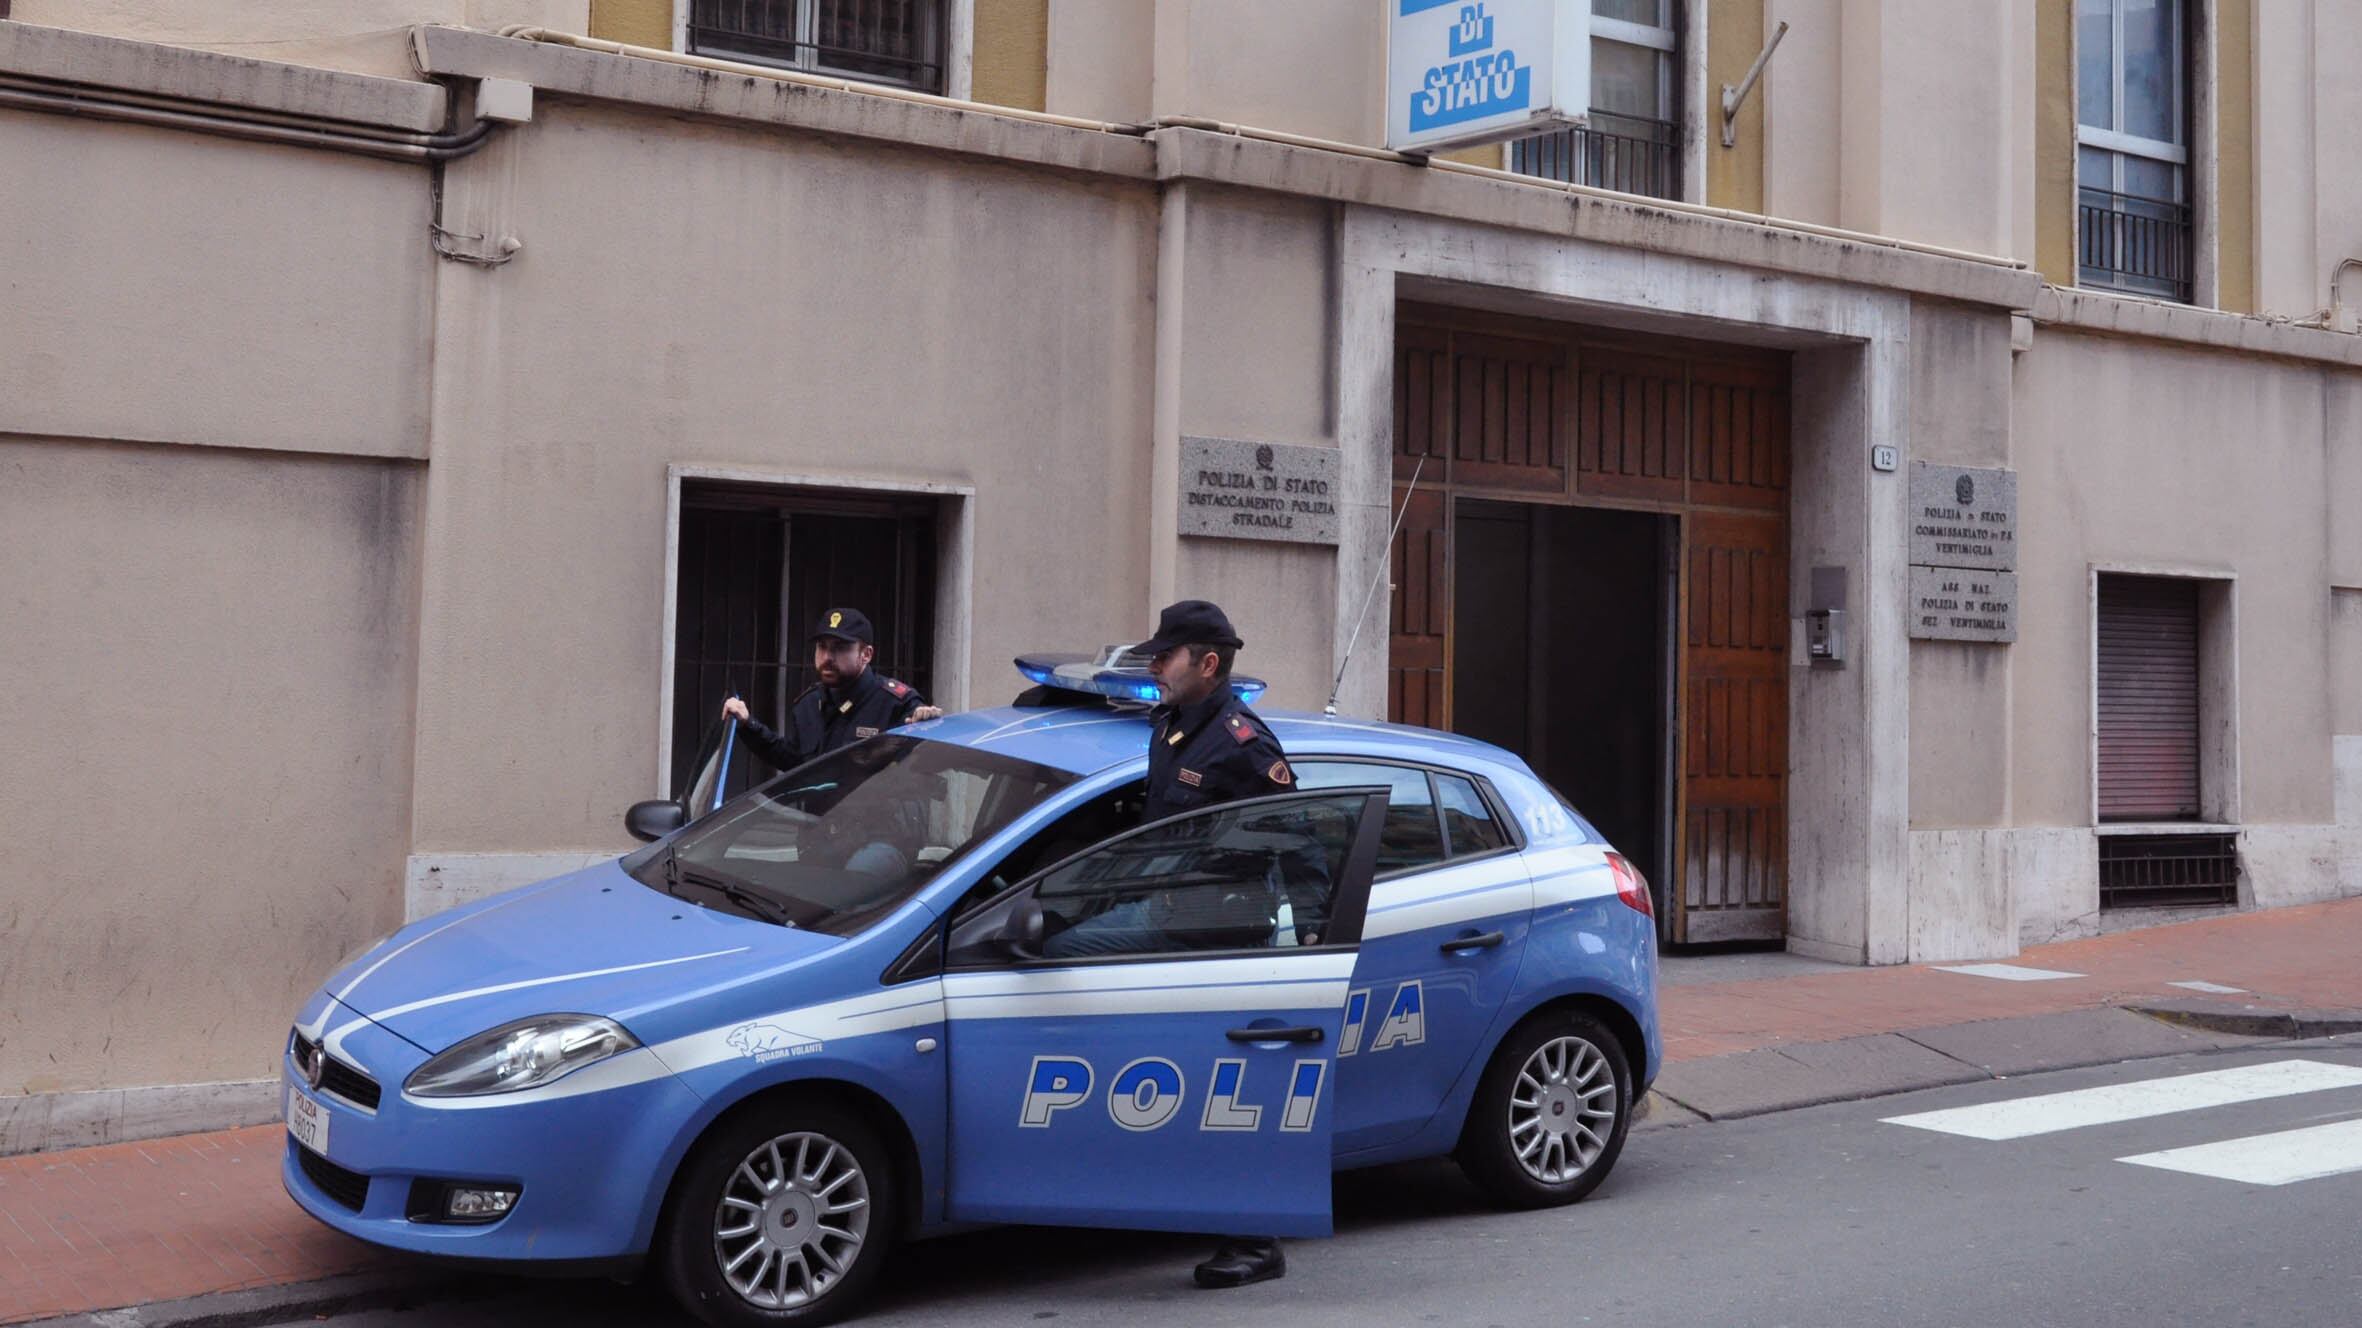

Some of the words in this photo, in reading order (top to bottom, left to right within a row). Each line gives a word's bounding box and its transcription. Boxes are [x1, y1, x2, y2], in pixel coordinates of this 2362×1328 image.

[1460, 2, 1484, 44] DI
[1422, 50, 1516, 116] STATO
[1880, 451, 1892, 466] 12
[1199, 471, 1255, 489] POLIZIA
[1263, 476, 1278, 491] DI
[1285, 479, 1328, 495] STATO
[1188, 492, 1285, 511] DISTACCAMENTO
[1292, 501, 1335, 515] POLIZIA
[1232, 513, 1293, 529] STRADALE
[1924, 507, 1961, 520] POLIZIA
[1980, 511, 2007, 522] STATO
[1915, 525, 1988, 539] COMMISSARIATO
[1935, 543, 1993, 555] VENTIMIGLIA
[1921, 598, 1958, 610] POLIZIA
[1965, 600, 1975, 611] DI
[1981, 602, 2008, 613] STATO
[1950, 617, 2006, 630] VENTIMIGLIA
[755, 1047, 790, 1064] SQUADRA
[791, 1043, 823, 1056] VOLANTE
[295, 1090, 317, 1119] POLIZIA
